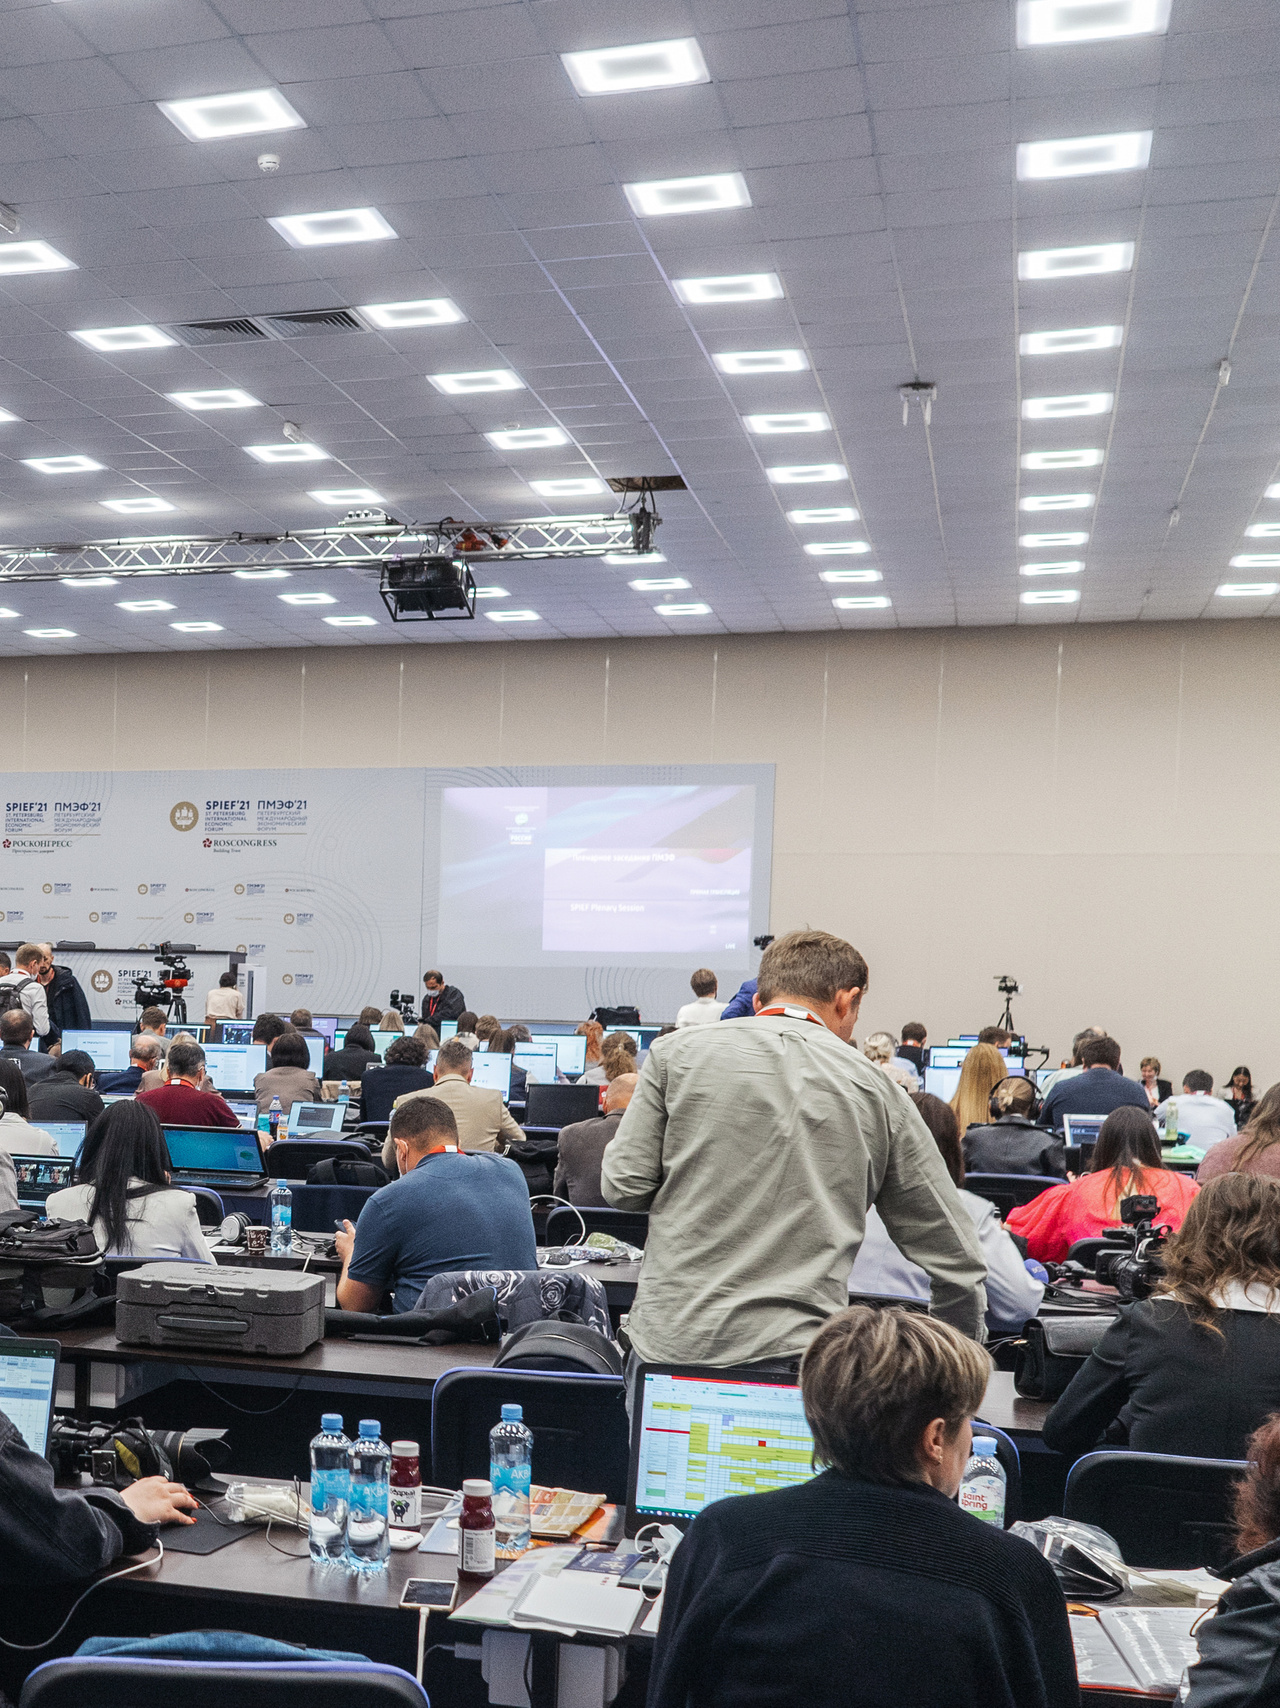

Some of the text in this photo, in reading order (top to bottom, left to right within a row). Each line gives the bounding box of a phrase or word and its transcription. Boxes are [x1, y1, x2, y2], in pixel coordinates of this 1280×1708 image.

[6, 803, 48, 812] SPIEF'21
[54, 802, 101, 812] ПМЭФ'21
[206, 800, 250, 810] SPIEF'21
[258, 800, 307, 810] ПМЭФ'21
[590, 904, 617, 913] Plenary
[963, 1493, 985, 1501] saint
[961, 1499, 988, 1511] spring
